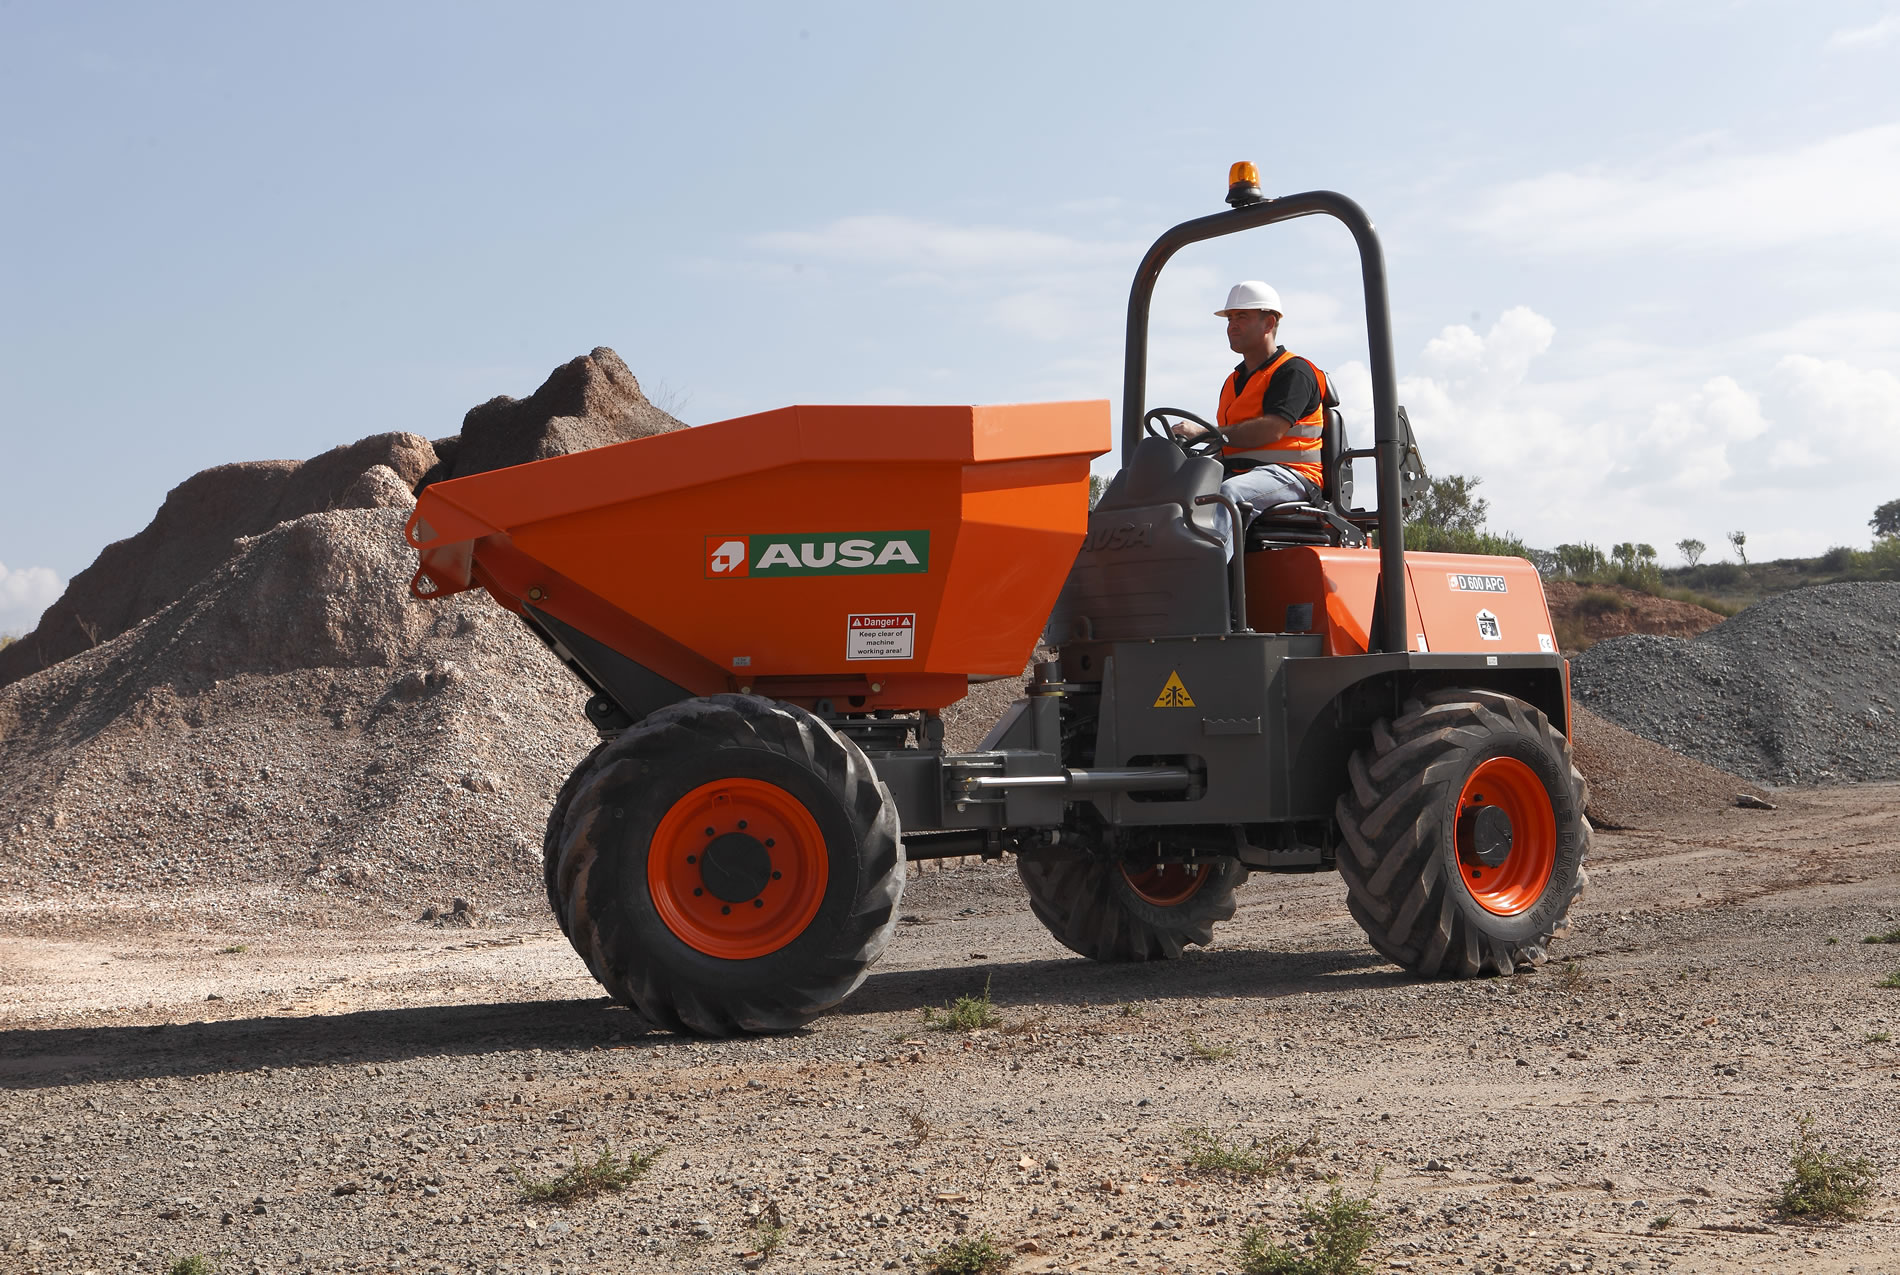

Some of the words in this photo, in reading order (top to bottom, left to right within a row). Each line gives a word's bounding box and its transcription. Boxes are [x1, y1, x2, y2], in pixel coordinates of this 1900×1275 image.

[755, 540, 920, 568] AUSA
[1458, 576, 1467, 589] D
[1467, 577, 1484, 590] 600
[1485, 577, 1505, 591] APG
[1540, 831, 1576, 917] DUMPER
